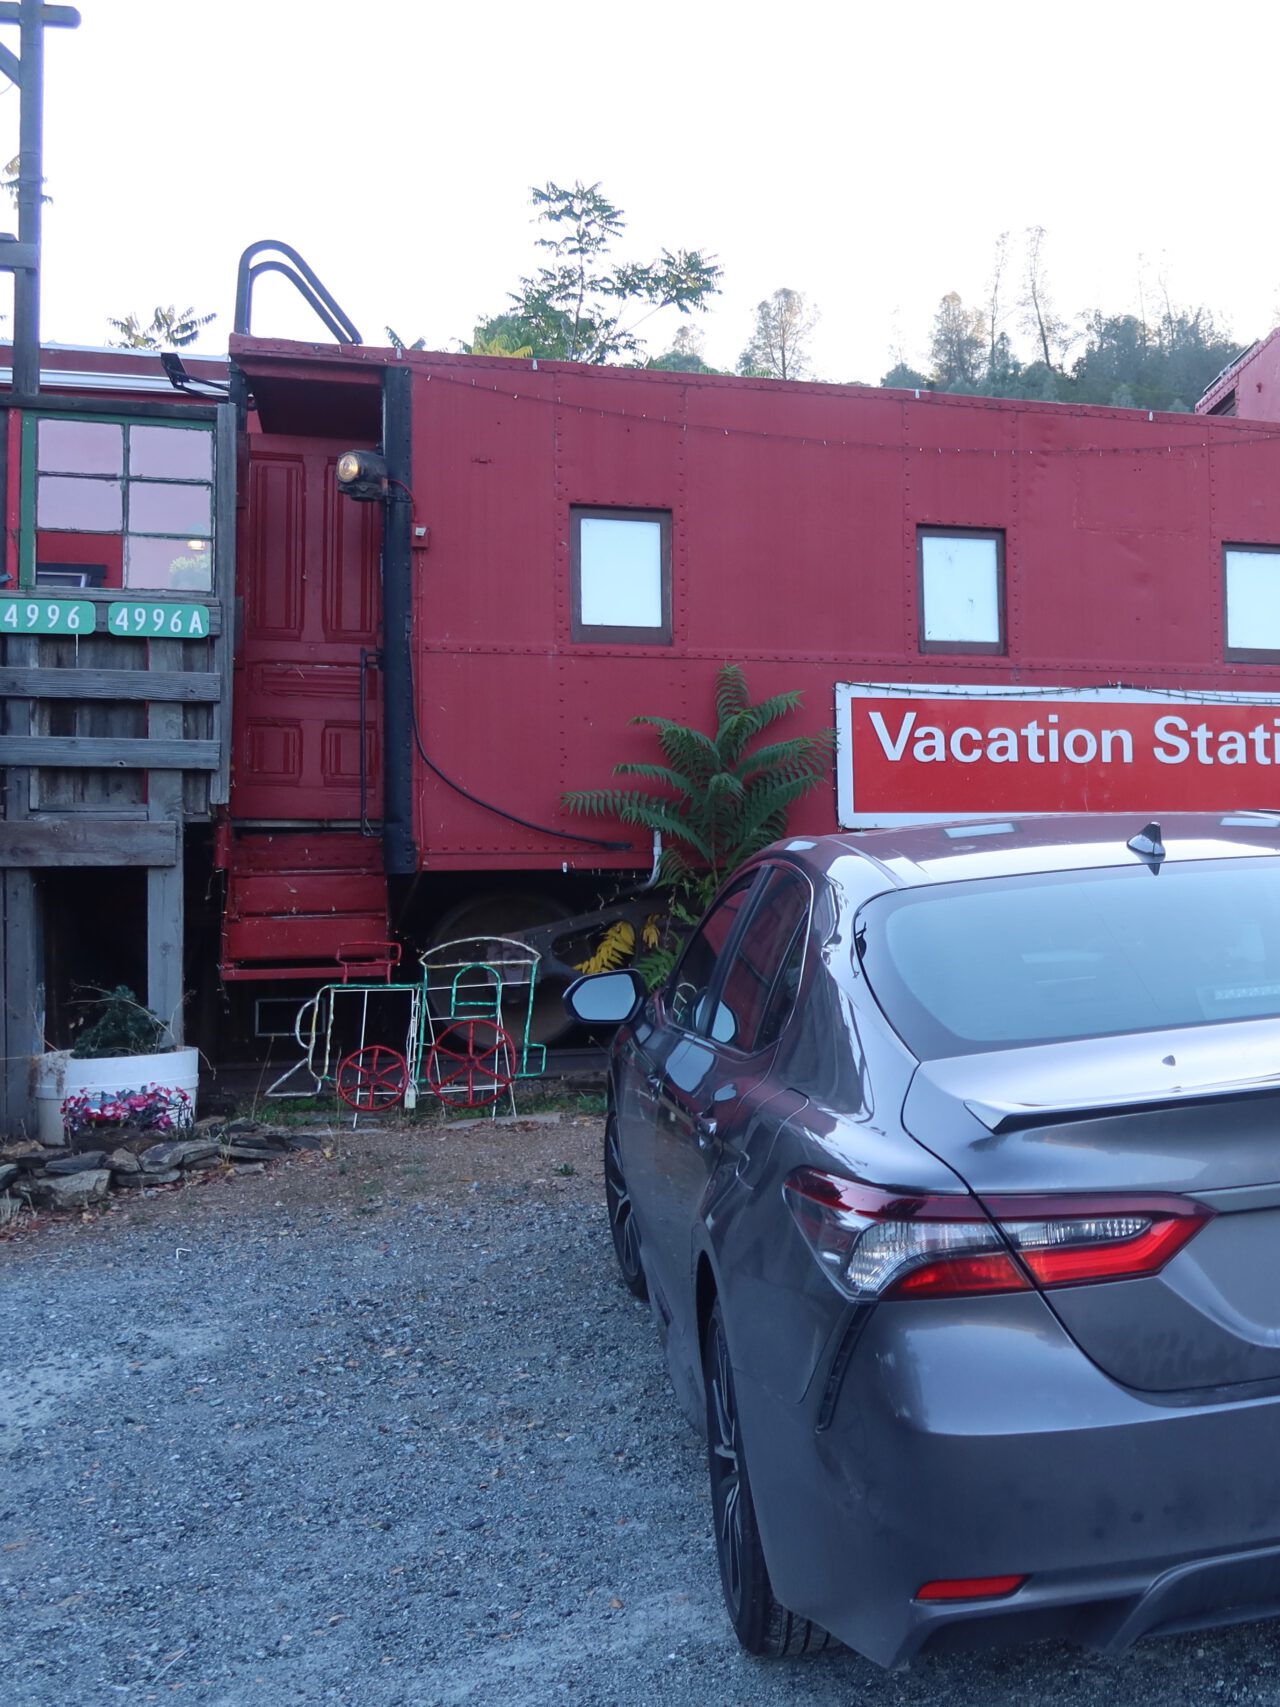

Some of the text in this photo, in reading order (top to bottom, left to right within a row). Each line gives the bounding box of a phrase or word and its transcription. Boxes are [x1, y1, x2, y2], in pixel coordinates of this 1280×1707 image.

[4, 604, 81, 629] 4996
[115, 607, 203, 634] 4996A
[869, 712, 1133, 763] Vacation
